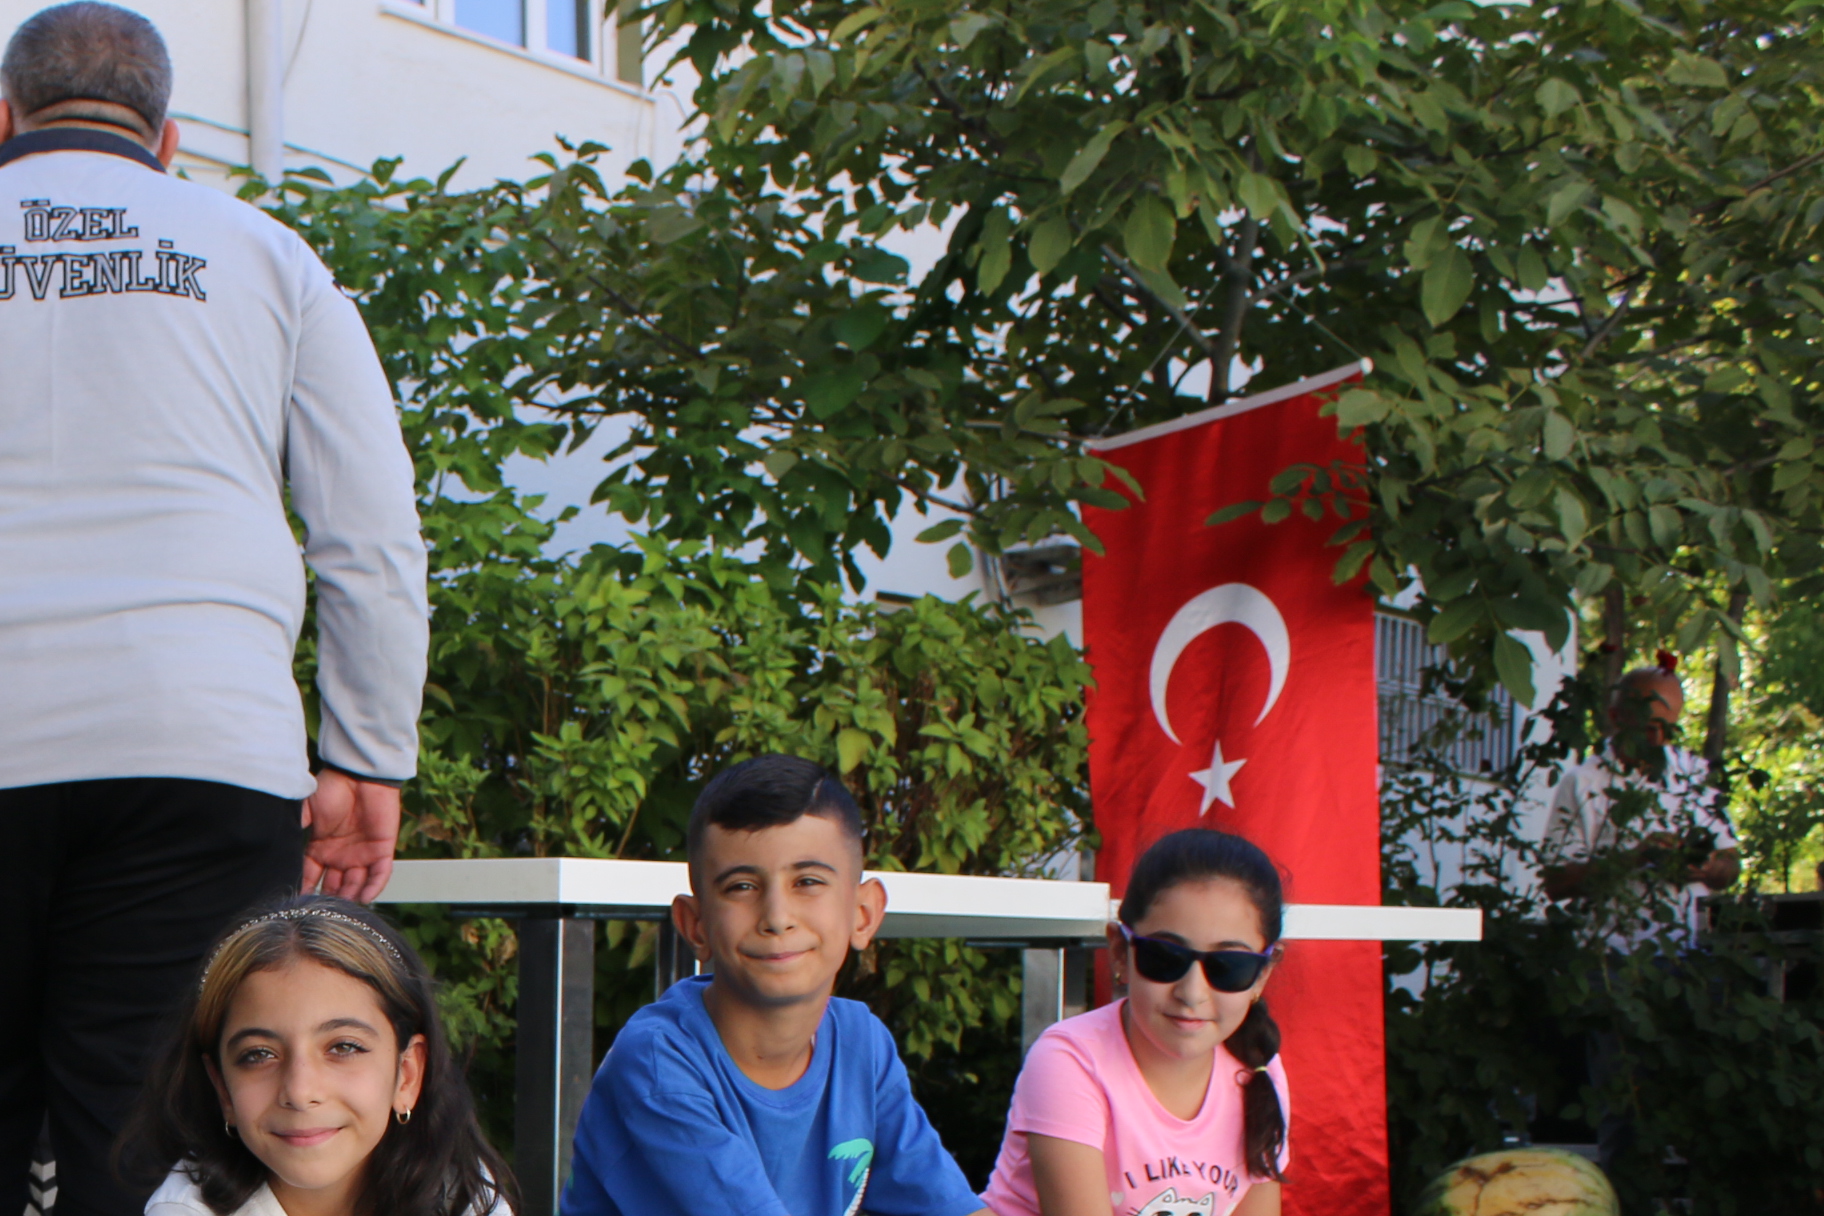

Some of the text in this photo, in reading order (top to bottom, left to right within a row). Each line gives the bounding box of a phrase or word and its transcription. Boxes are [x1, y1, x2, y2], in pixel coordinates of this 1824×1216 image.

[20, 198, 139, 242] ÖZEL
[1124, 1171, 1137, 1190] I
[1145, 1156, 1192, 1182] LIKE
